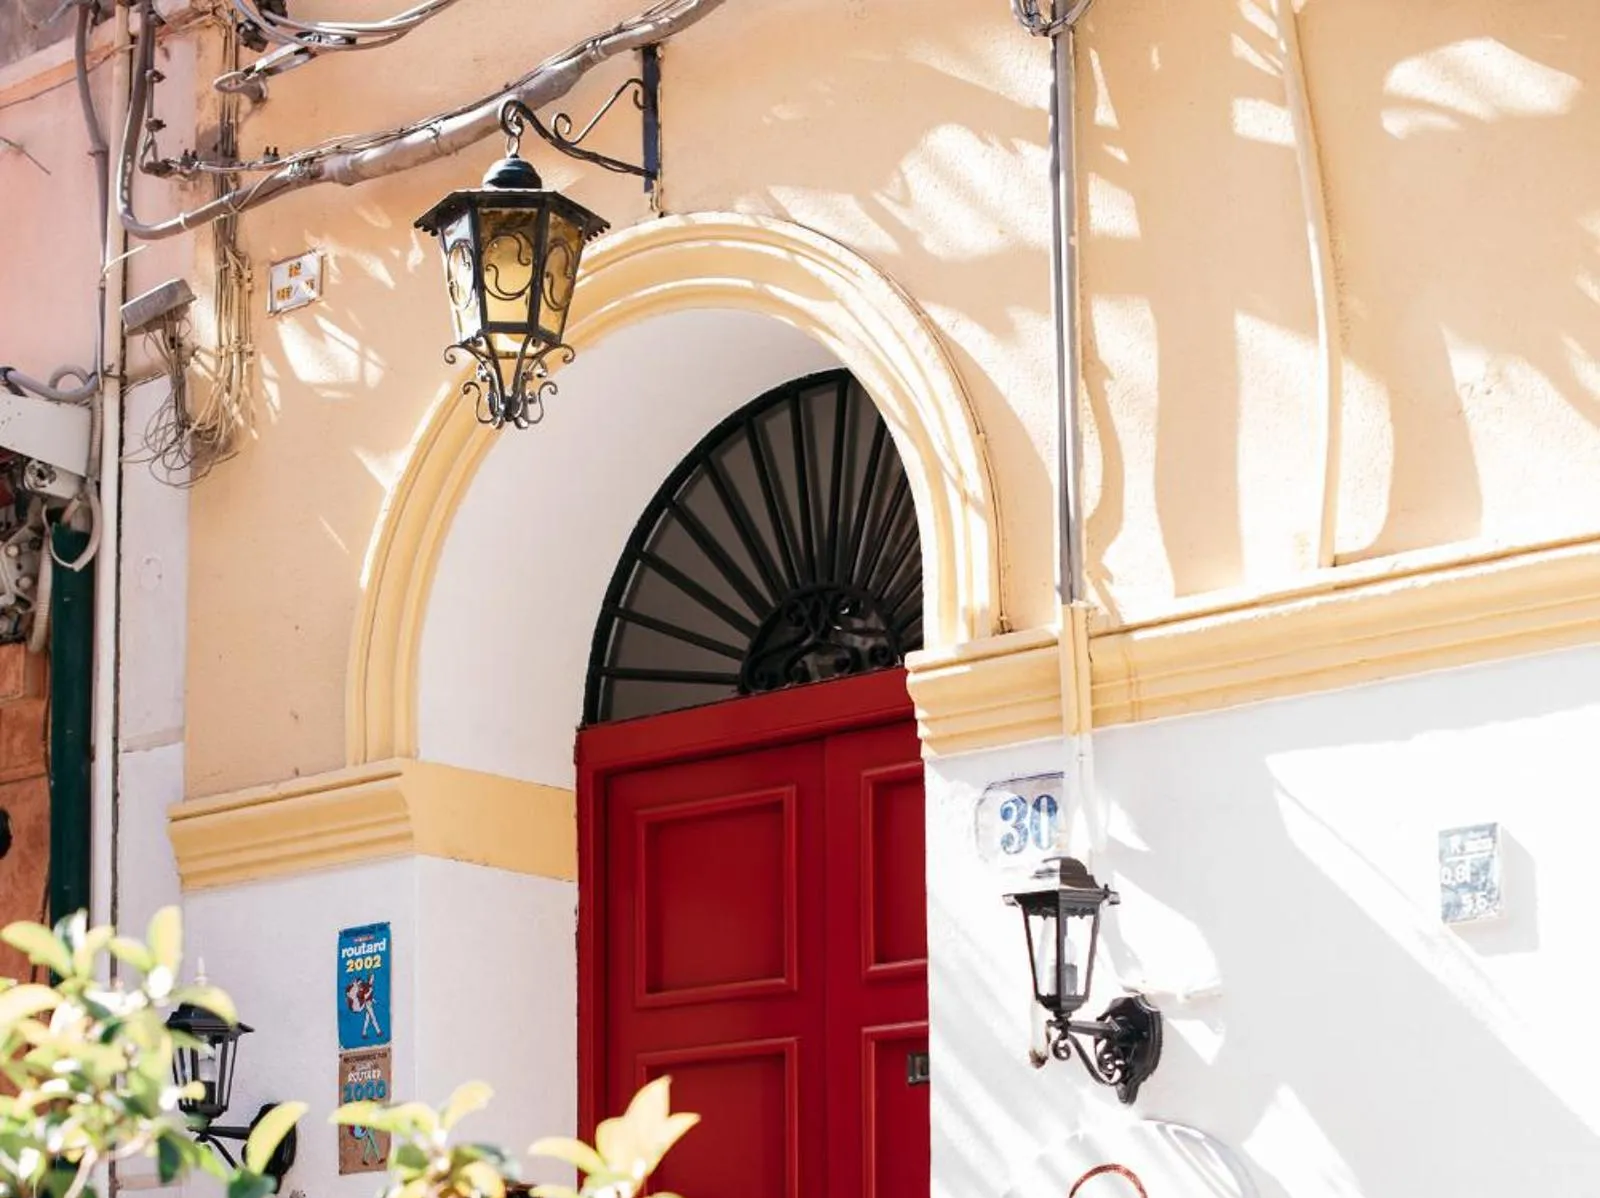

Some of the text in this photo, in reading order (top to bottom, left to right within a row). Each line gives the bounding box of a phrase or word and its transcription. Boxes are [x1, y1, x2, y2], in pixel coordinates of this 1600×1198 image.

[999, 794, 1058, 855] 30
[341, 937, 386, 959] routard
[345, 954, 382, 973] 2002
[342, 1079, 386, 1104] 2000
